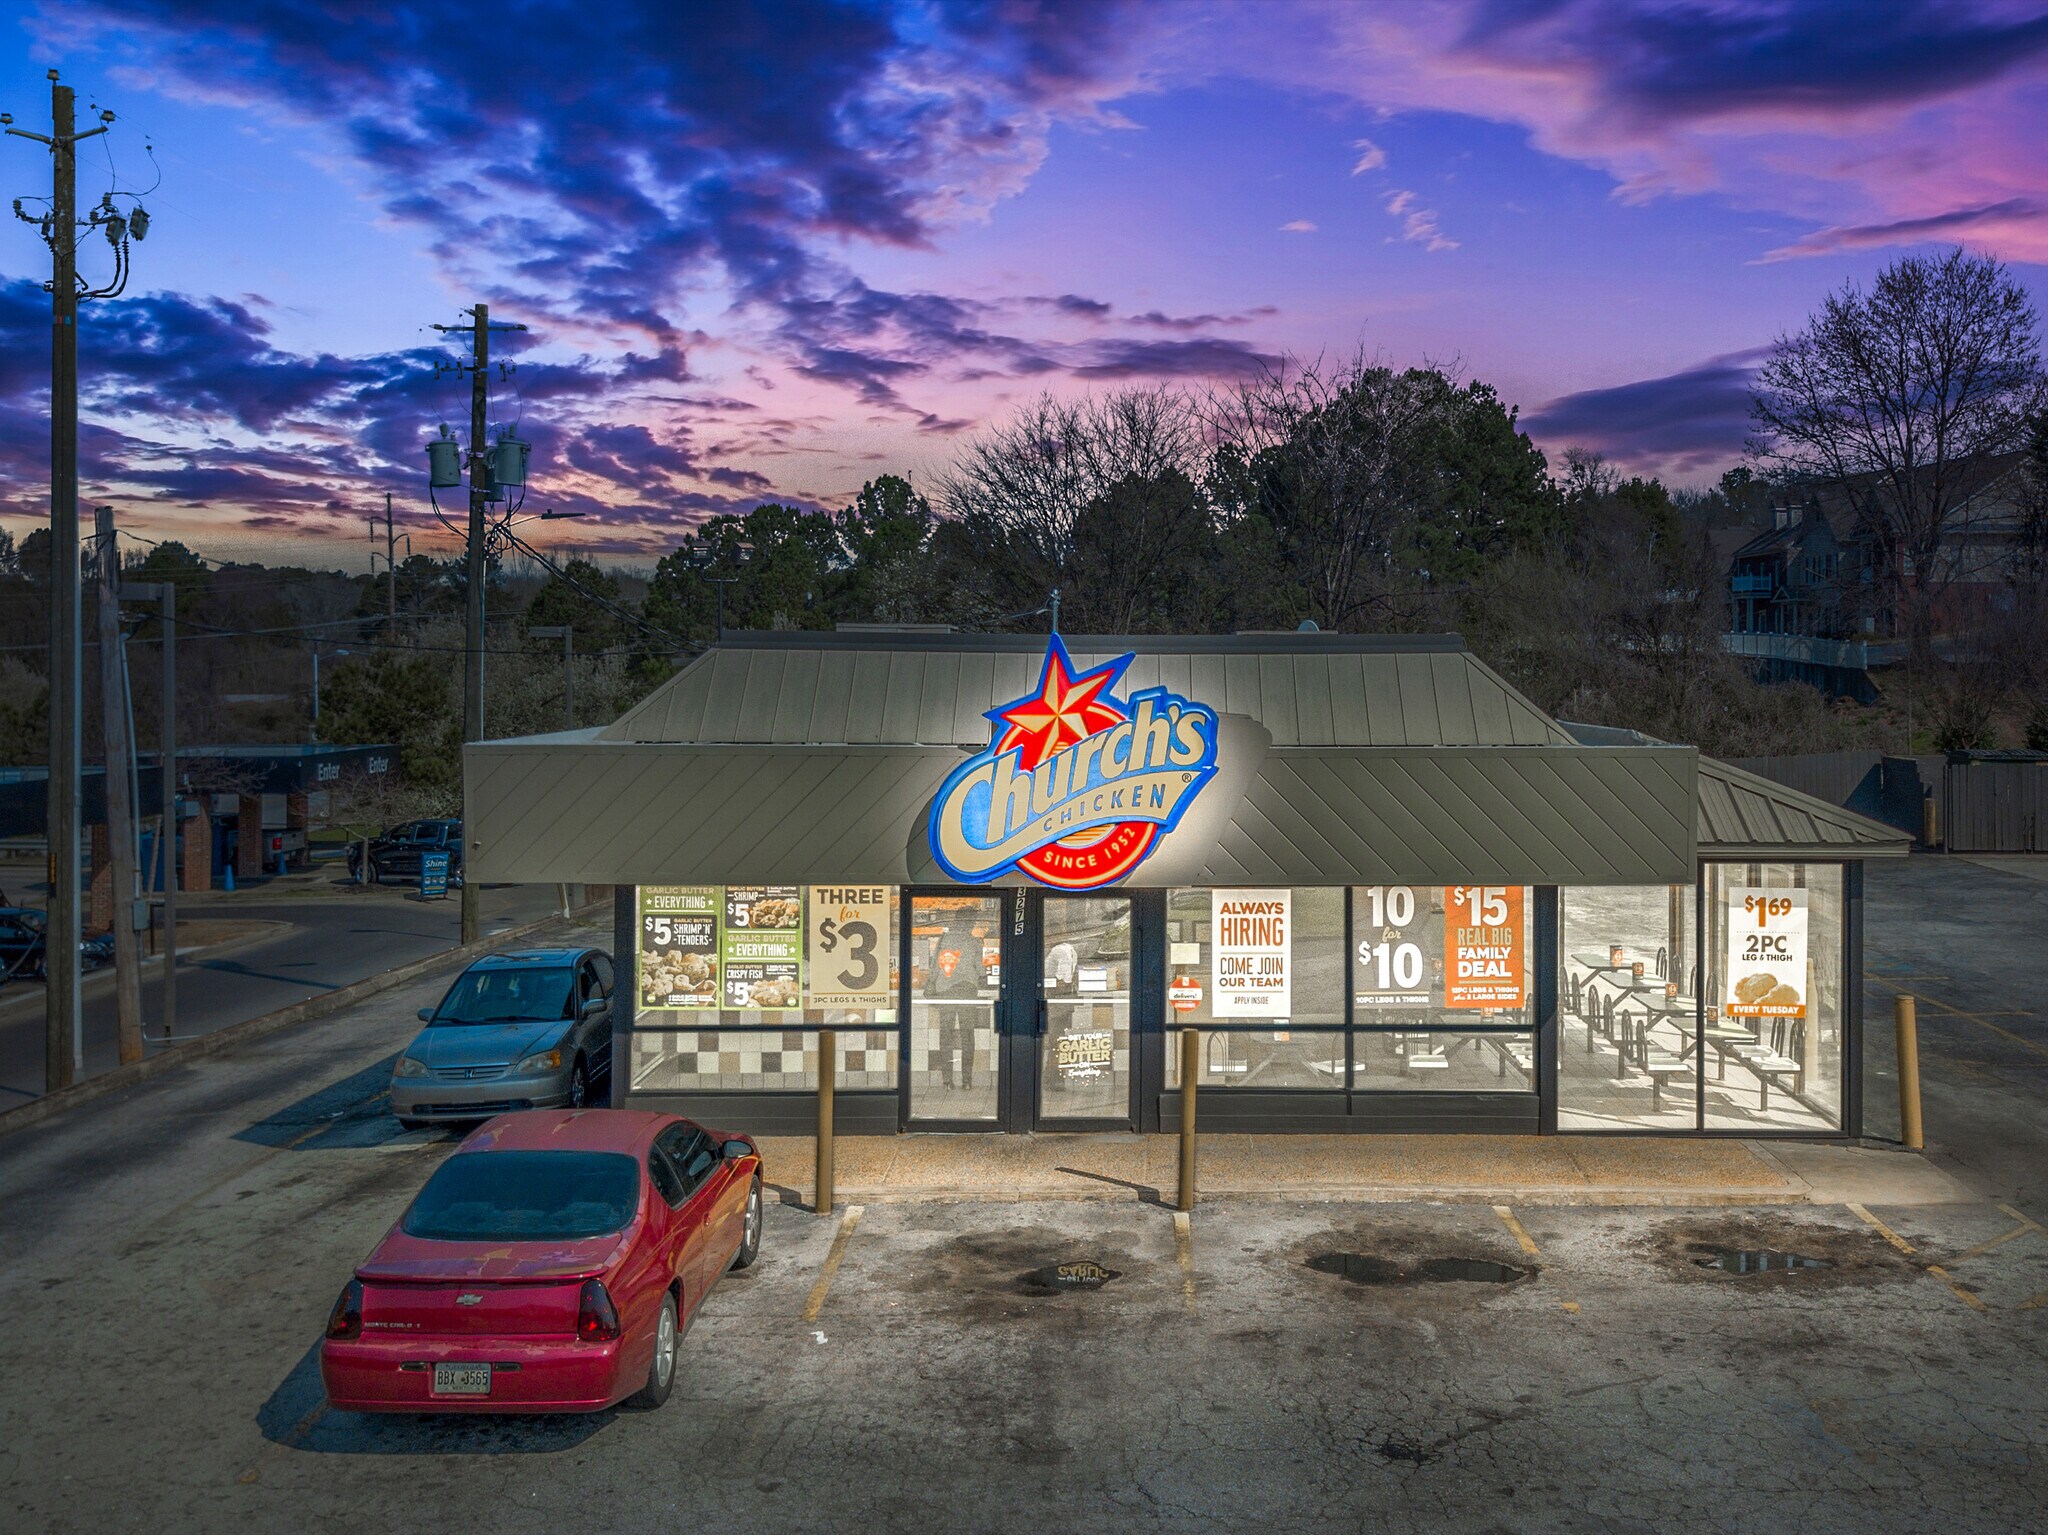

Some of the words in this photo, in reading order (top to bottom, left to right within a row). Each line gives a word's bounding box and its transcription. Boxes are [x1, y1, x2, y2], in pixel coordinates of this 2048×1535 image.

[318, 763, 339, 781] Enter
[369, 757, 389, 773] Enter
[939, 700, 1206, 873] Church's
[1043, 783, 1166, 832] CHICKEN
[1044, 851, 1097, 868] SINCE
[1104, 827, 1135, 859] 1952
[425, 859, 447, 868] Shine
[654, 896, 706, 909] EVERYTHING
[733, 891, 759, 901] SHRIMP
[816, 888, 884, 905] THREE
[840, 905, 861, 923] for
[1220, 902, 1284, 914] ALWAYS
[1367, 886, 1415, 927] 10
[1454, 886, 1508, 927] $15
[727, 903, 750, 927] $5
[645, 917, 672, 945] $5
[673, 923, 701, 935] SHRIMP
[1221, 918, 1284, 946] HIRING
[1382, 926, 1402, 942] for
[1458, 927, 1489, 946] REAL
[1492, 927, 1512, 946] BIG
[736, 944, 788, 956] EVERYTHING
[1746, 935, 1787, 953] 2PC
[819, 917, 879, 990] $3
[1458, 947, 1511, 959] FAMILY
[1767, 954, 1793, 962] THIGH
[1220, 957, 1253, 975] COME
[1257, 957, 1284, 975] JOIN
[1358, 941, 1424, 989] $10
[1458, 961, 1512, 977] DEAL
[726, 970, 747, 979] CRISPY
[749, 970, 763, 979] FISH
[1219, 978, 1245, 987] OUR
[1250, 978, 1284, 987] TEAM
[726, 981, 749, 1006] $5
[1234, 996, 1250, 1005] APPLY
[1251, 996, 1269, 1005] INSIDE
[1762, 1006, 1799, 1014] TUESDAY
[1059, 1038, 1111, 1052] GARLIC
[1059, 1050, 1111, 1064] BUTTER
[437, 1371, 456, 1385] BBX
[463, 1371, 488, 1386] 3565
